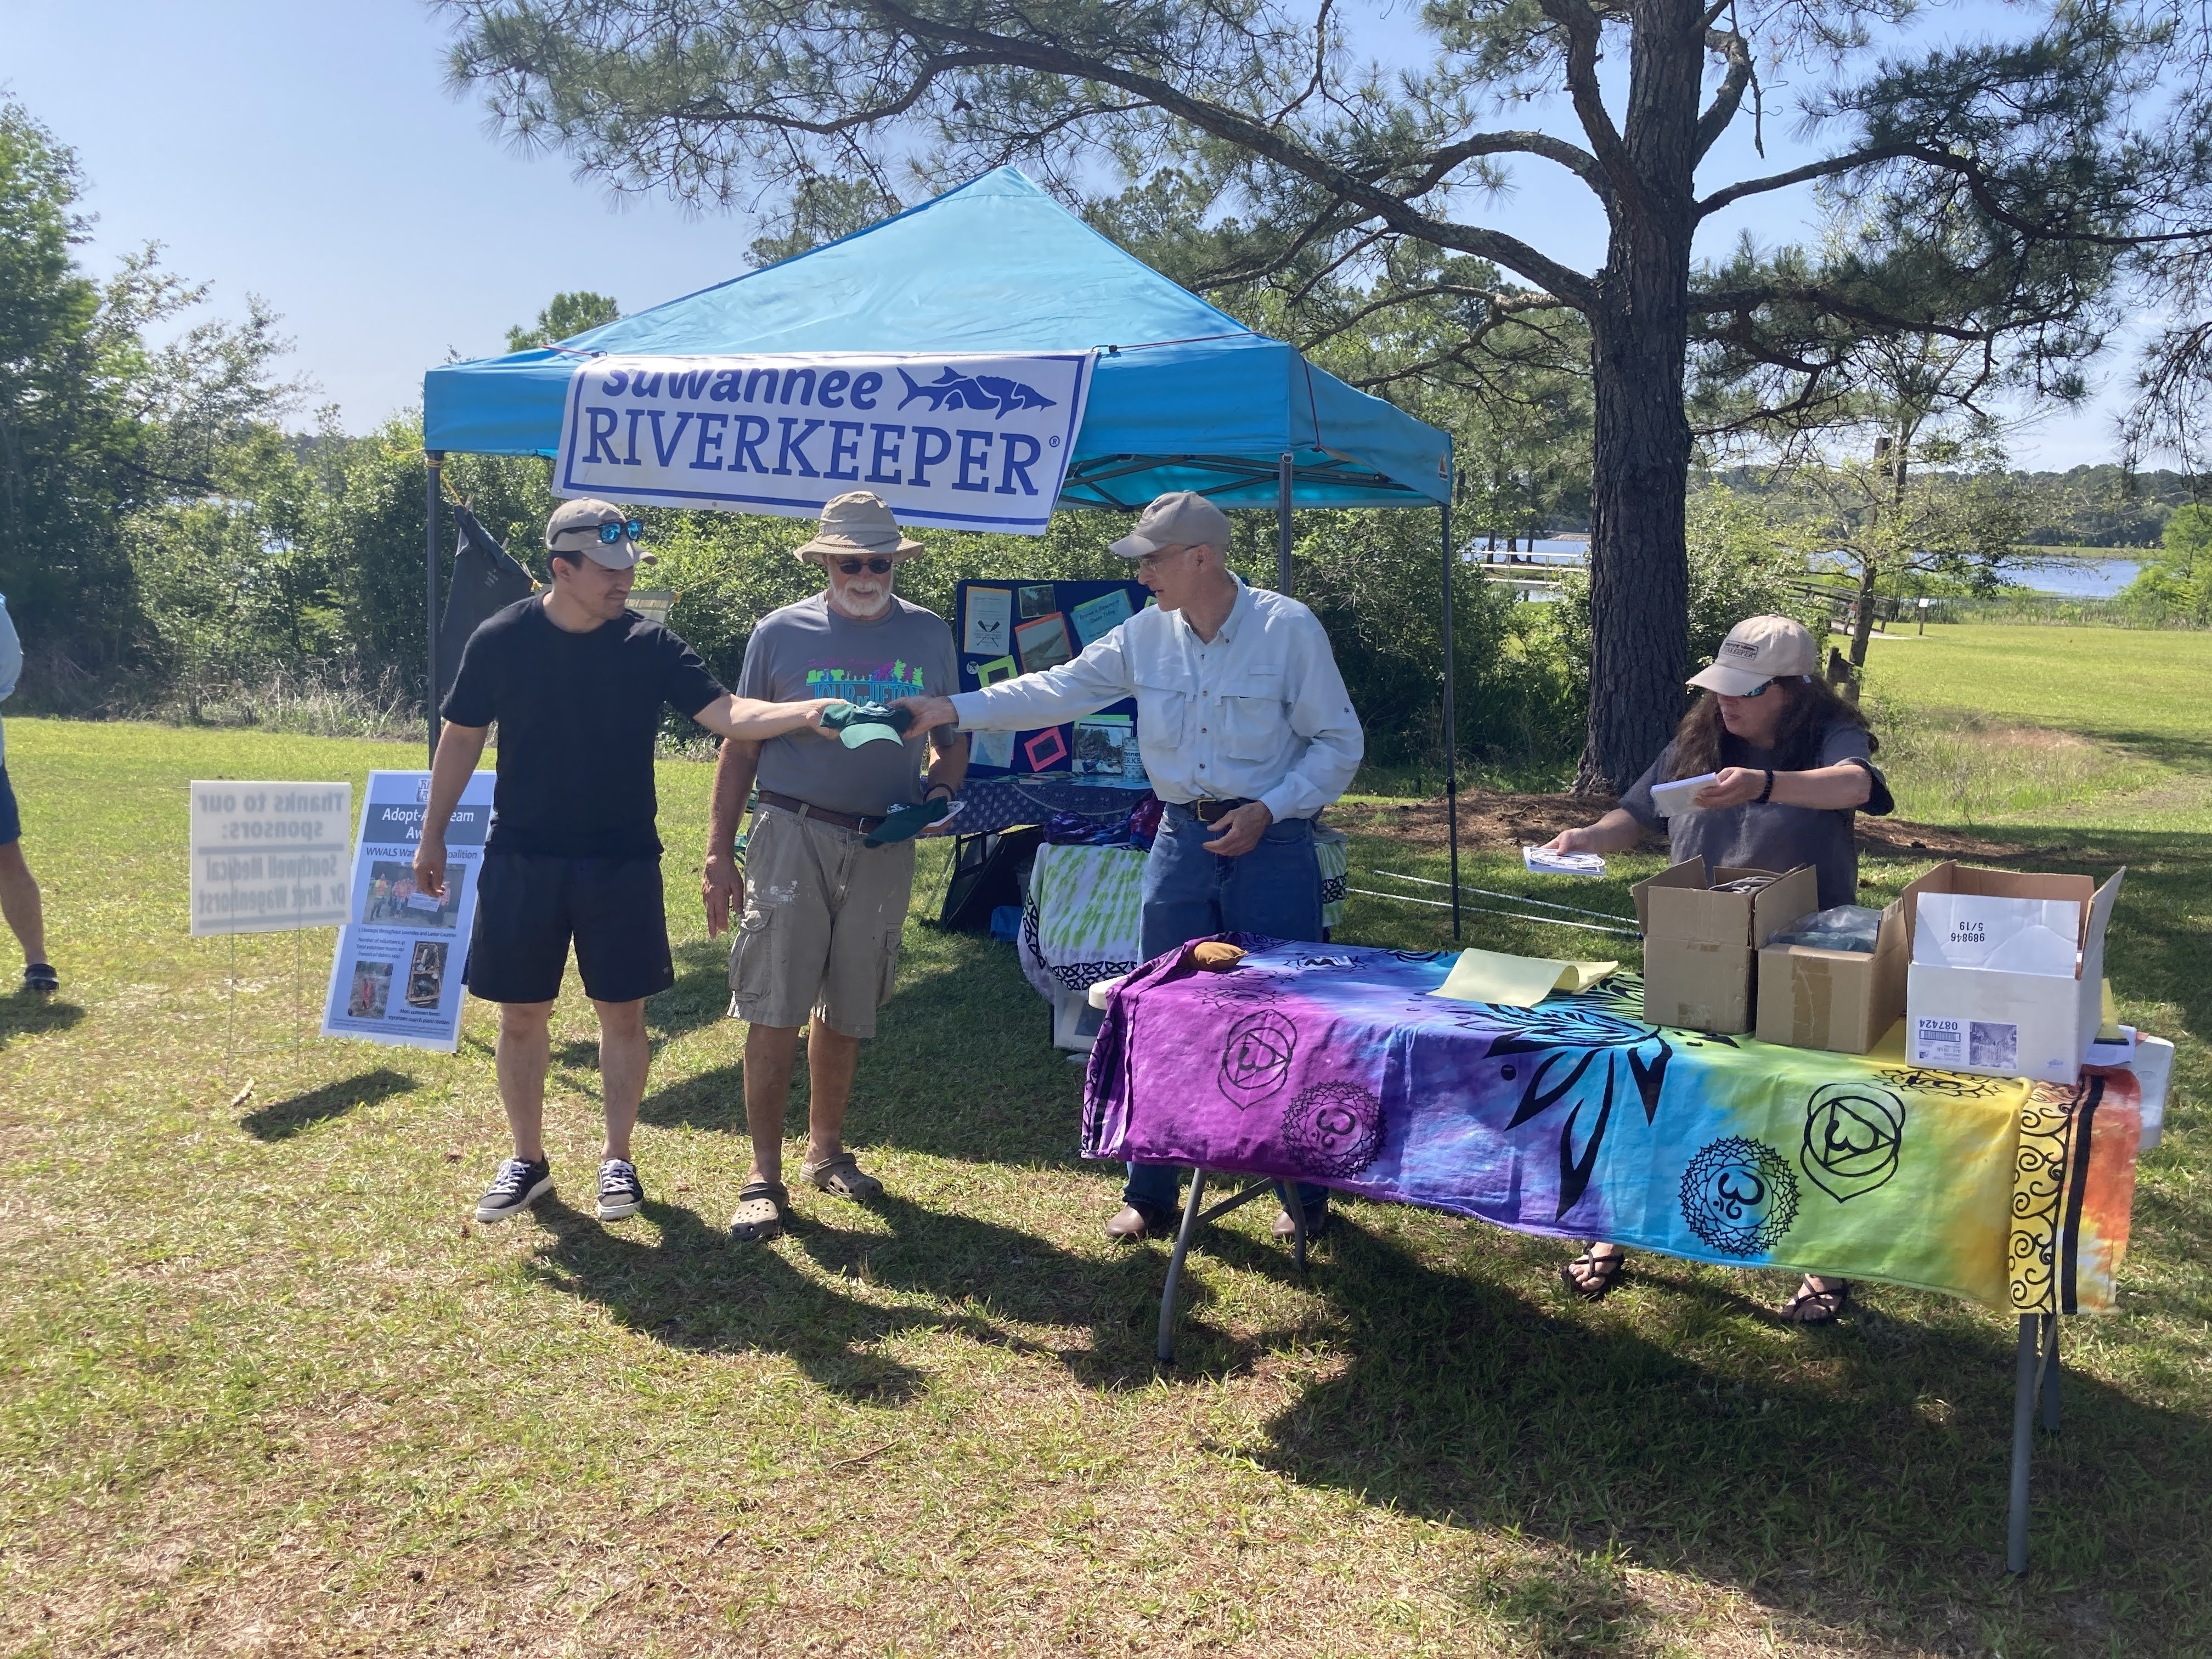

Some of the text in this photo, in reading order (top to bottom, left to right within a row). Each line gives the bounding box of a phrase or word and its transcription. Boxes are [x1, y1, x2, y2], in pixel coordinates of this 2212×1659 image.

[602, 368, 883, 410] suwannee
[366, 848, 397, 856] WWALS
[448, 850, 477, 859] oalition
[1960, 922, 1983, 931] 5/19
[1951, 933, 1985, 942] 989846
[1919, 1019, 1958, 1030] 087424
